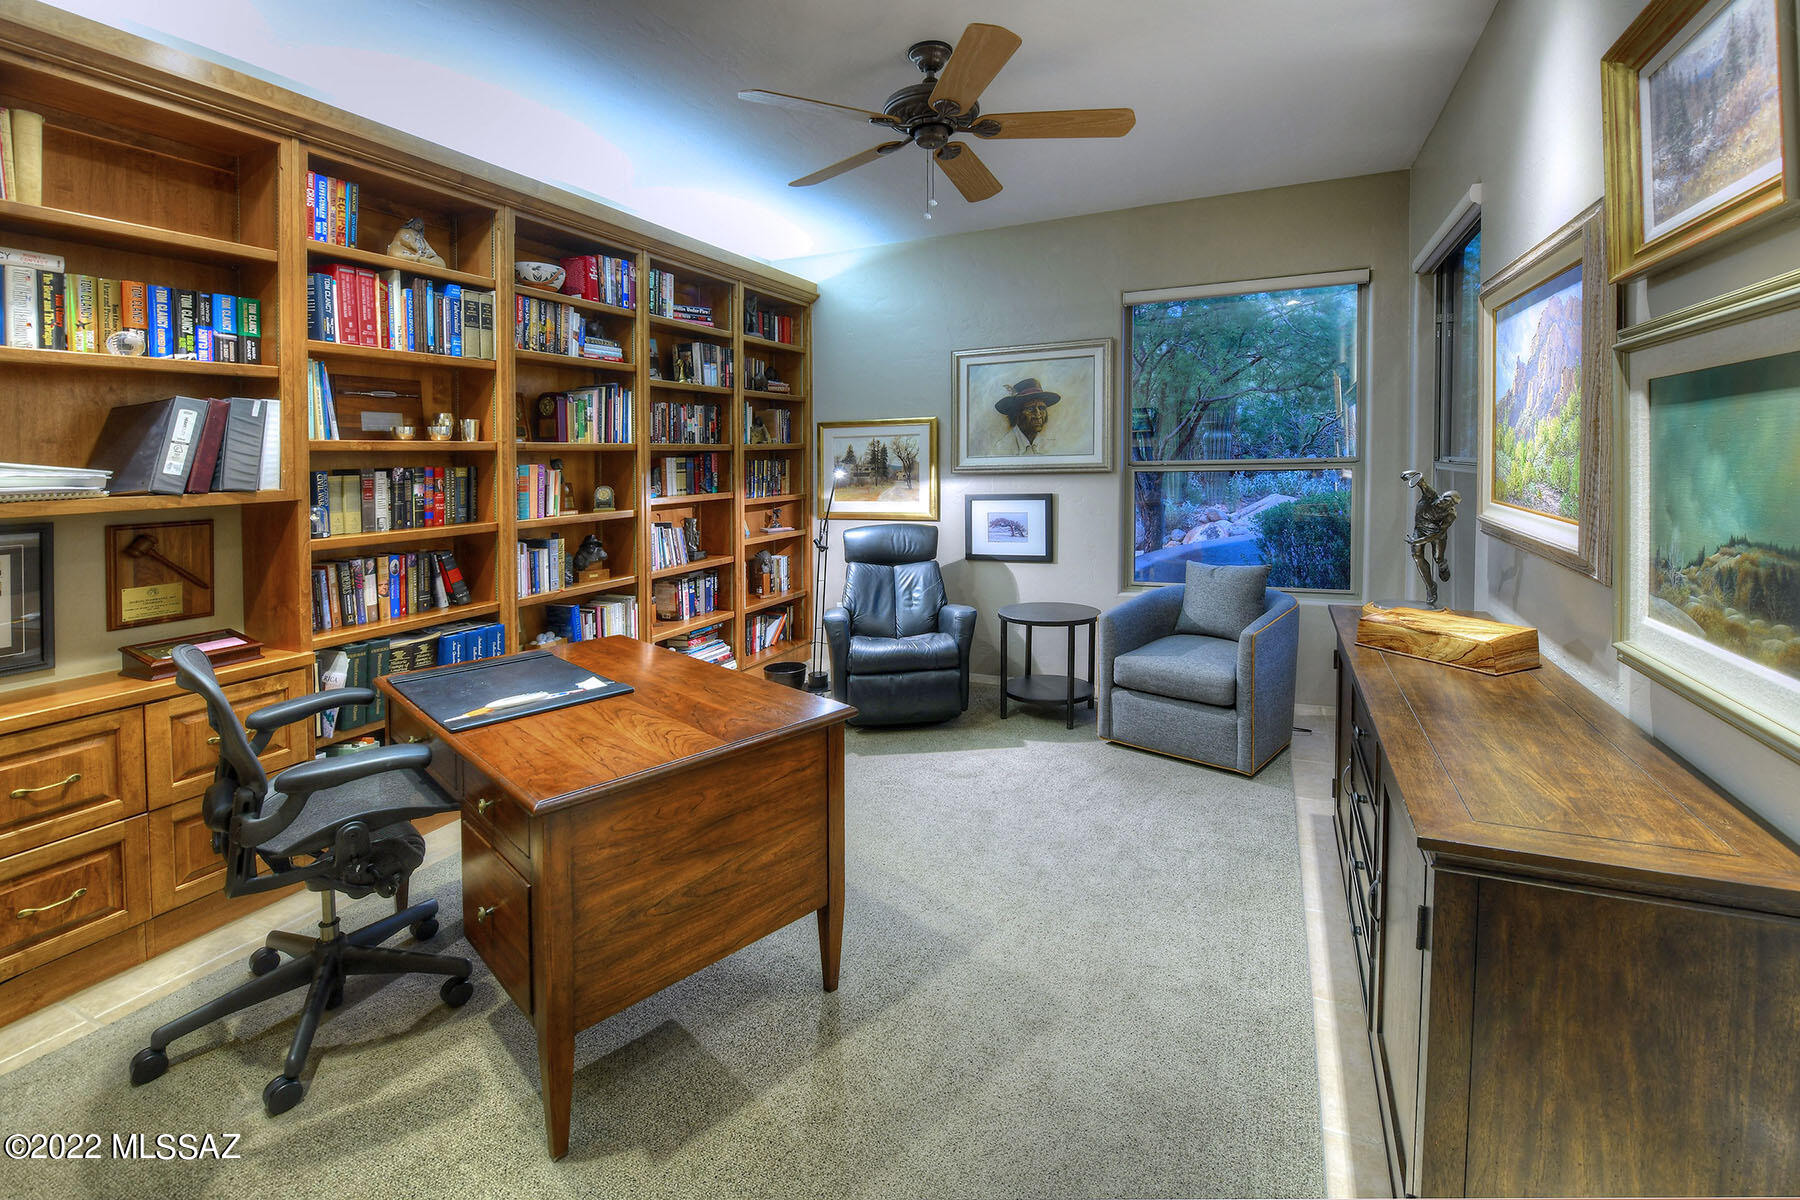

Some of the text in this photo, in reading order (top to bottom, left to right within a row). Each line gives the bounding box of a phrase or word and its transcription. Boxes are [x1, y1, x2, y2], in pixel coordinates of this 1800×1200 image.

[306, 188, 315, 208] CRAIS
[338, 197, 346, 237] ECLIPSE
[80, 279, 92, 294] TOM
[156, 289, 168, 303] TOM
[324, 278, 332, 314] TOM CLANCY
[42, 273, 54, 346] The Bear and The Dragon
[80, 294, 93, 320] CLANCY
[131, 285, 144, 324] TOM CLANCY
[156, 304, 169, 329] CLANCY
[180, 294, 193, 335] TOM CLANCY
[221, 296, 232, 332] TOM CLANCY
[248, 303, 258, 335] TOM CLANCY
[197, 328, 209, 361] TOM CLANCY
[316, 474, 324, 491] CIVIL
[317, 492, 325, 507] WAR
[354, 573, 363, 590] 1776
